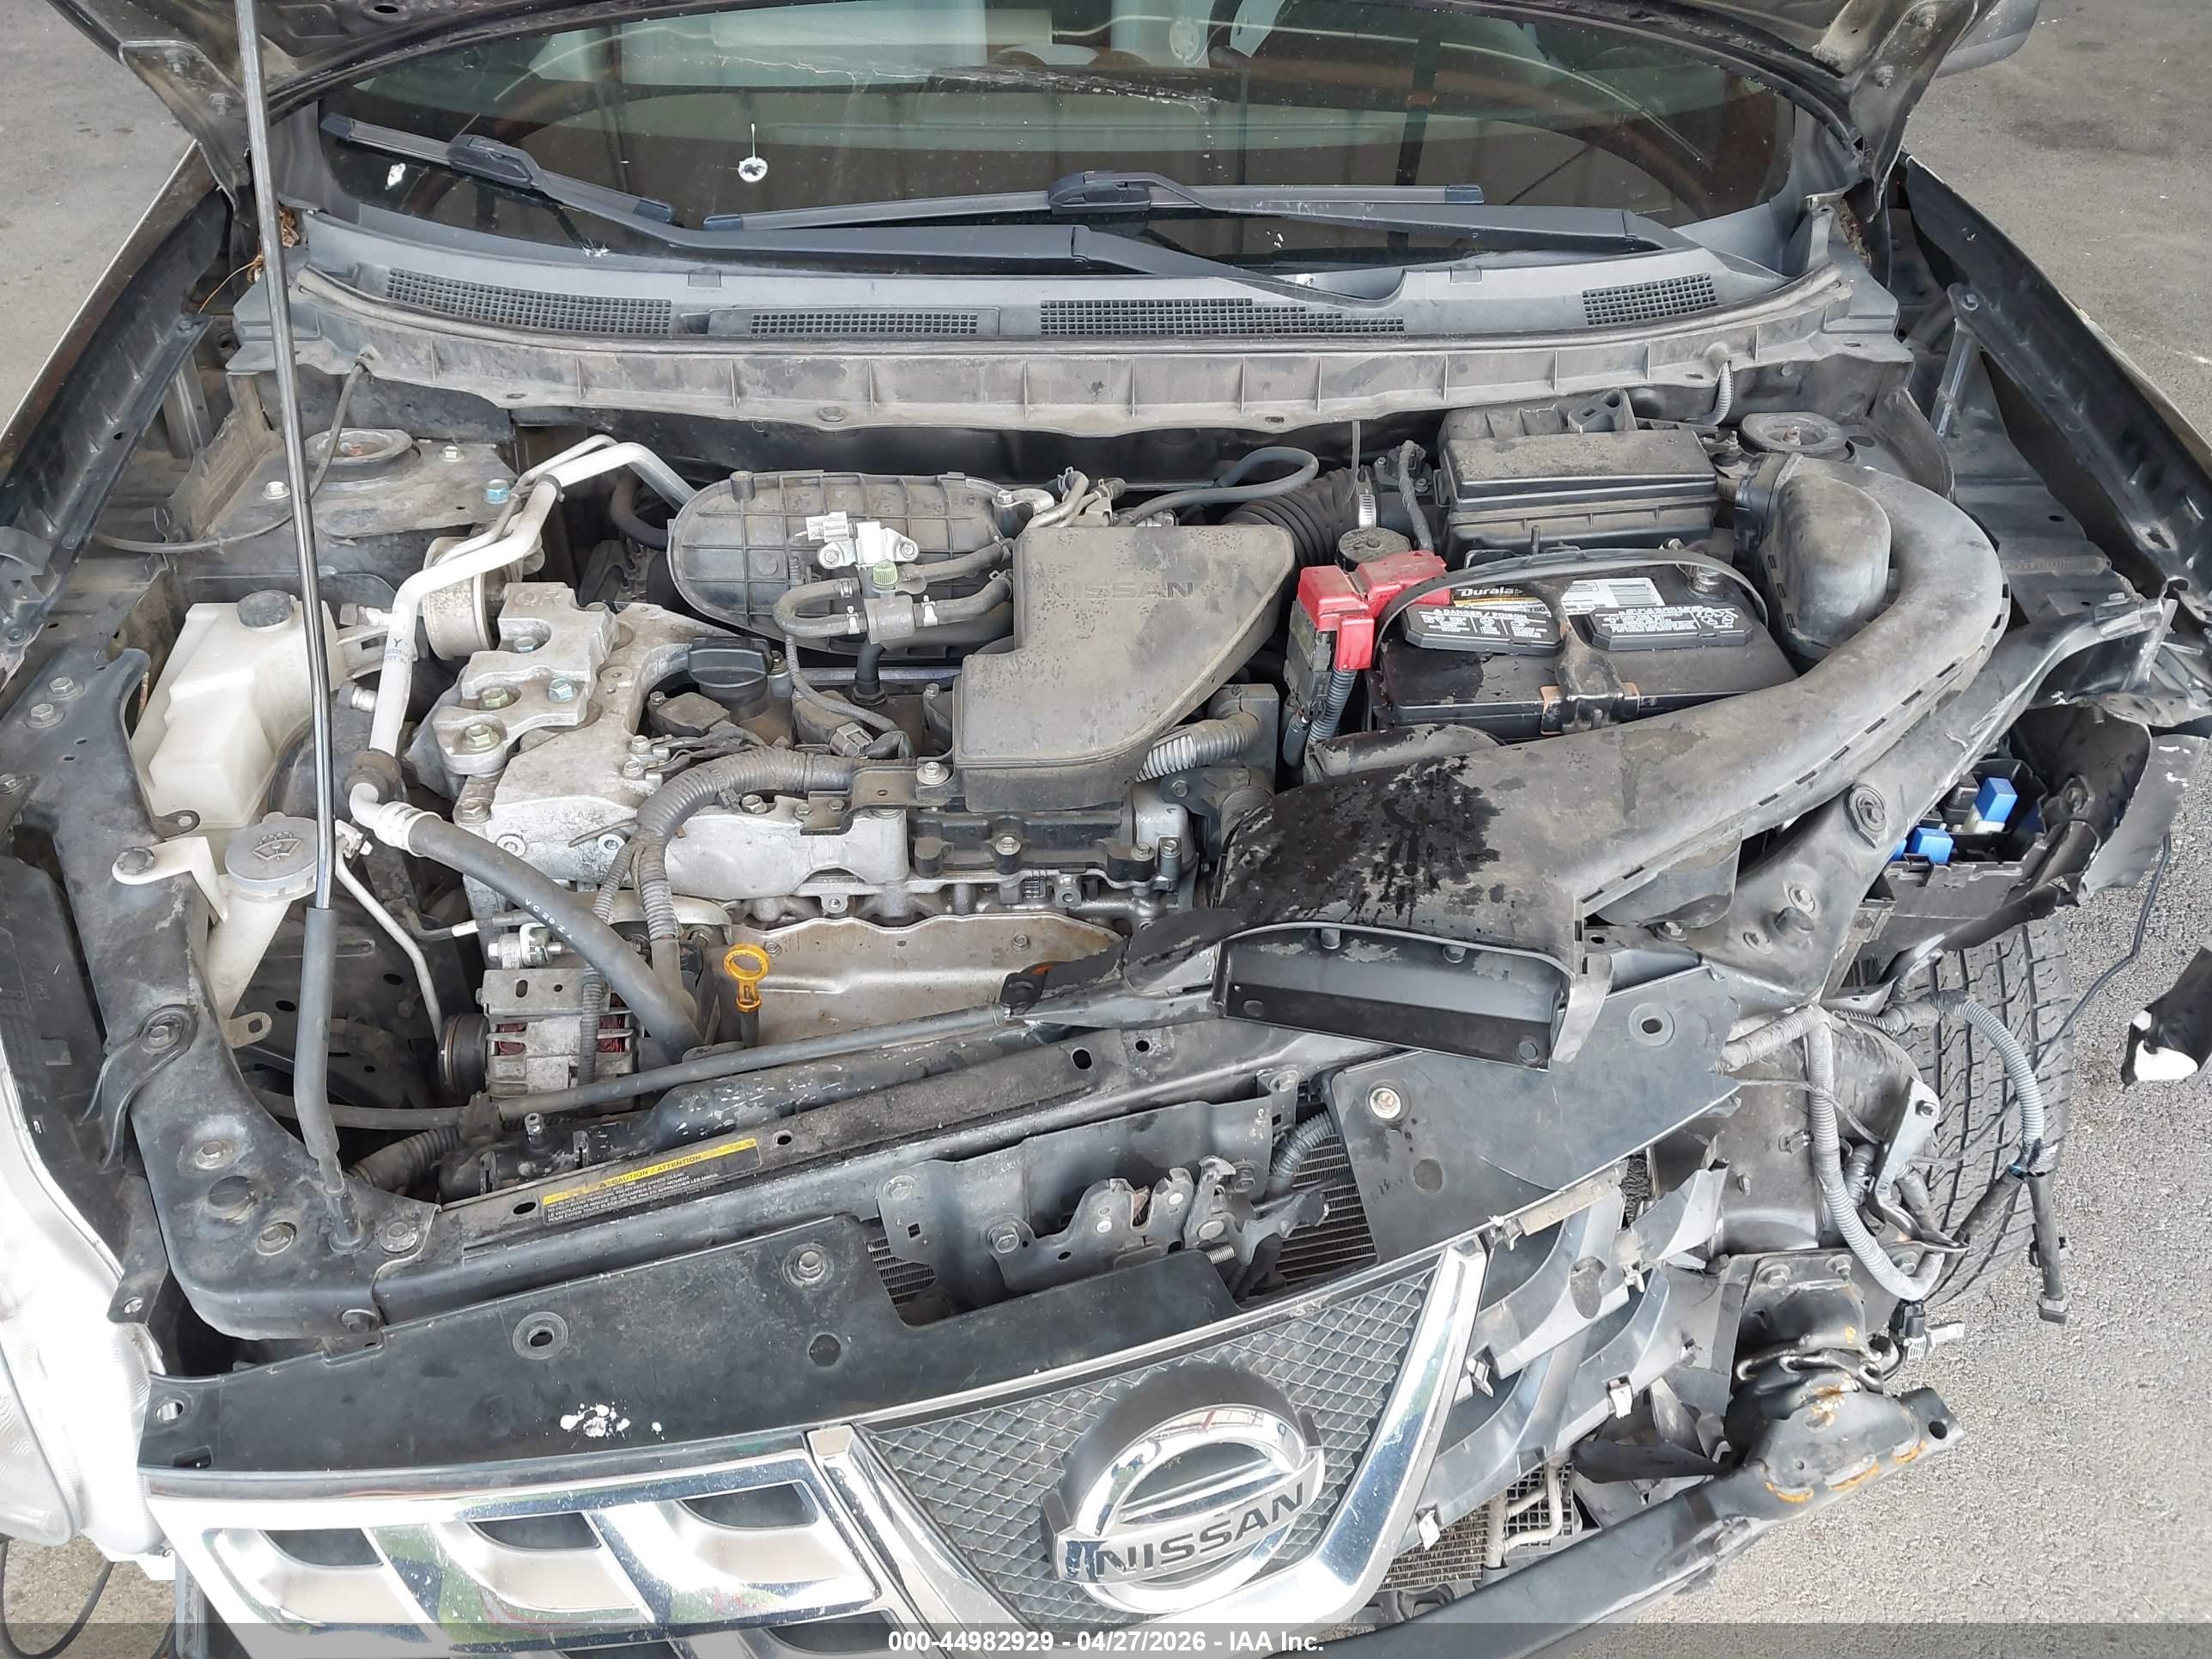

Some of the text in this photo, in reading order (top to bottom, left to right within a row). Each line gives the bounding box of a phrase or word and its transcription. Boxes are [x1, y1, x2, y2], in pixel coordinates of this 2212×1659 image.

[1443, 608, 1482, 617] DANGER
[1492, 611, 1528, 620] POISON
[611, 1170, 648, 1184] CAUTION
[656, 1154, 702, 1171] ATTENTION
[1096, 1481, 1304, 1577] NISSAN
